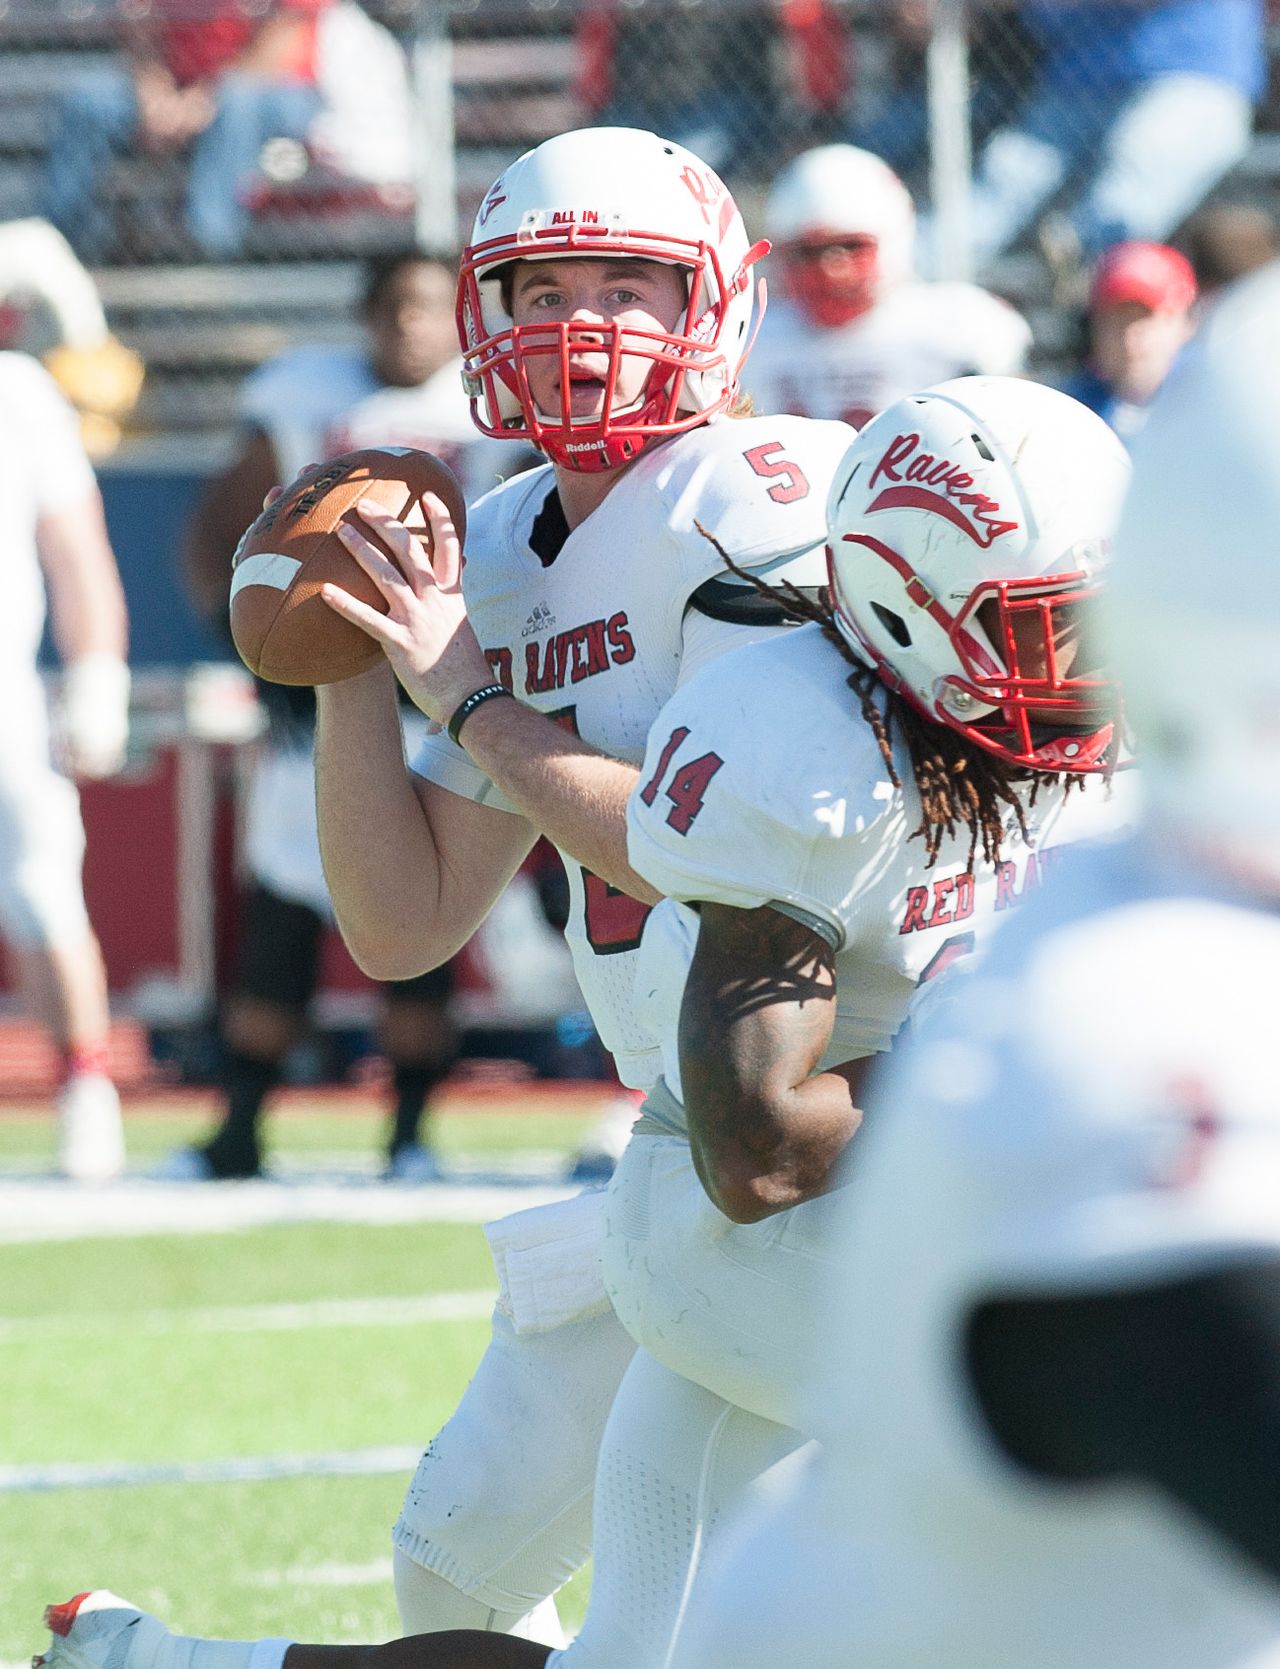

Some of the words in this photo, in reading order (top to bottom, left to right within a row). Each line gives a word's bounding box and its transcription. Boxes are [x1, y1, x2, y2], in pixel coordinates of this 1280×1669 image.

[552, 211, 576, 225] ALL
[582, 210, 598, 223] IN
[742, 441, 810, 504] 5
[868, 433, 1019, 541] Ravens
[525, 610, 636, 696] RAVENS
[640, 726, 725, 838] 14
[898, 871, 976, 935] RED
